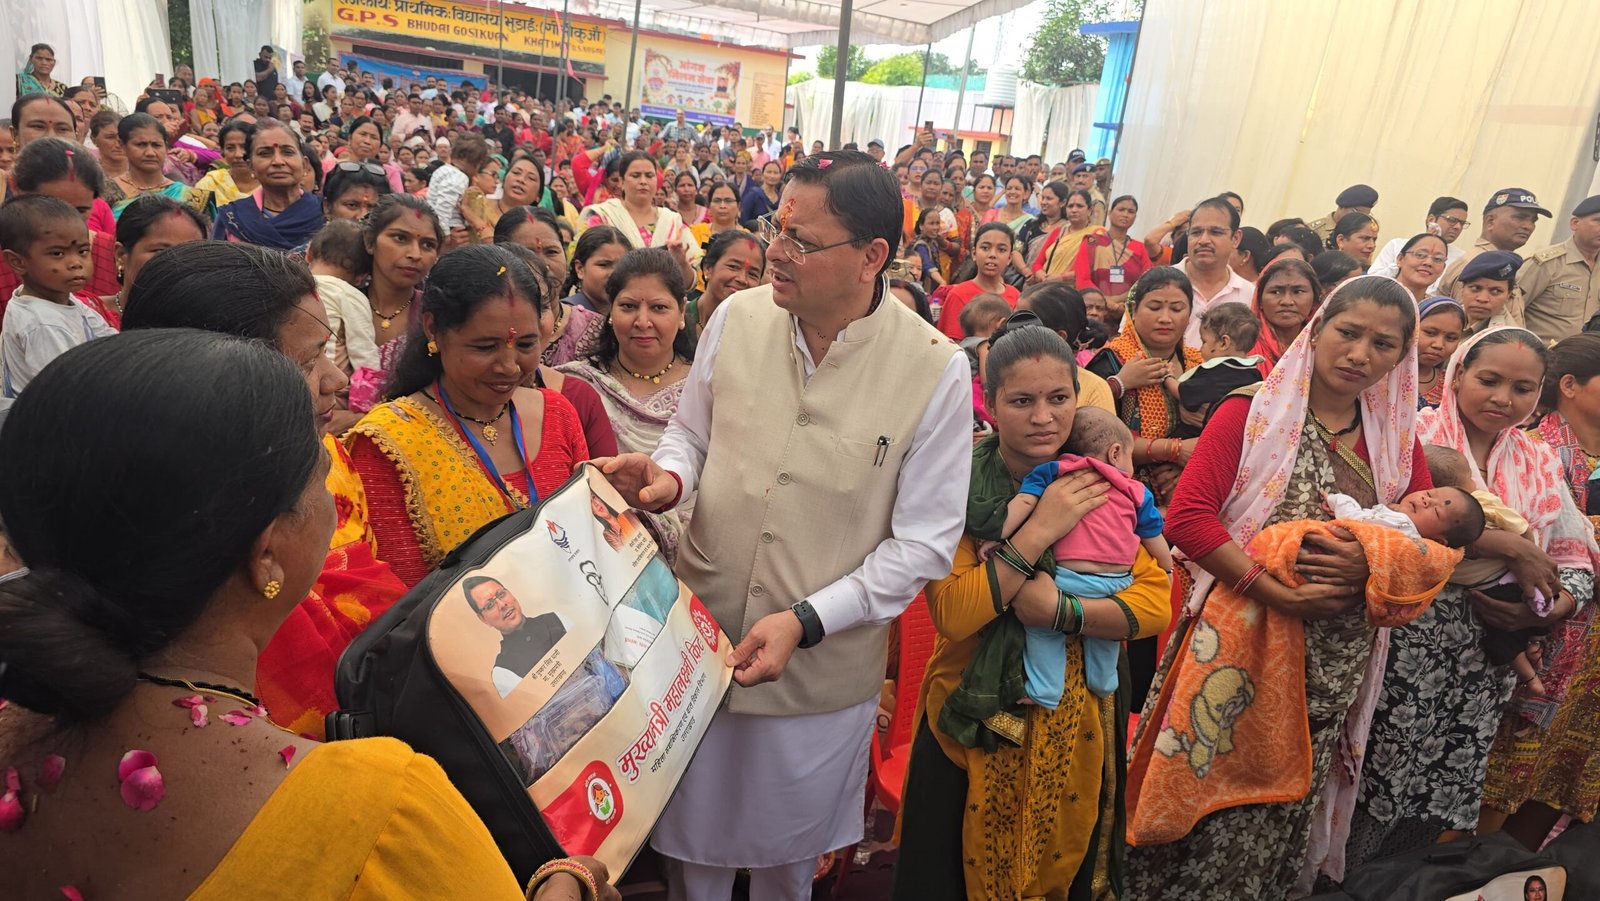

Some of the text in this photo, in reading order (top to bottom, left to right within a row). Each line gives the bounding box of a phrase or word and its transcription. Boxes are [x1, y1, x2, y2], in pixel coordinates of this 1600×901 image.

[452, 6, 501, 26] विद्यालय
[407, 19, 450, 34] BHUDAI
[524, 36, 563, 49] KHATIM
[684, 635, 705, 664] किट
